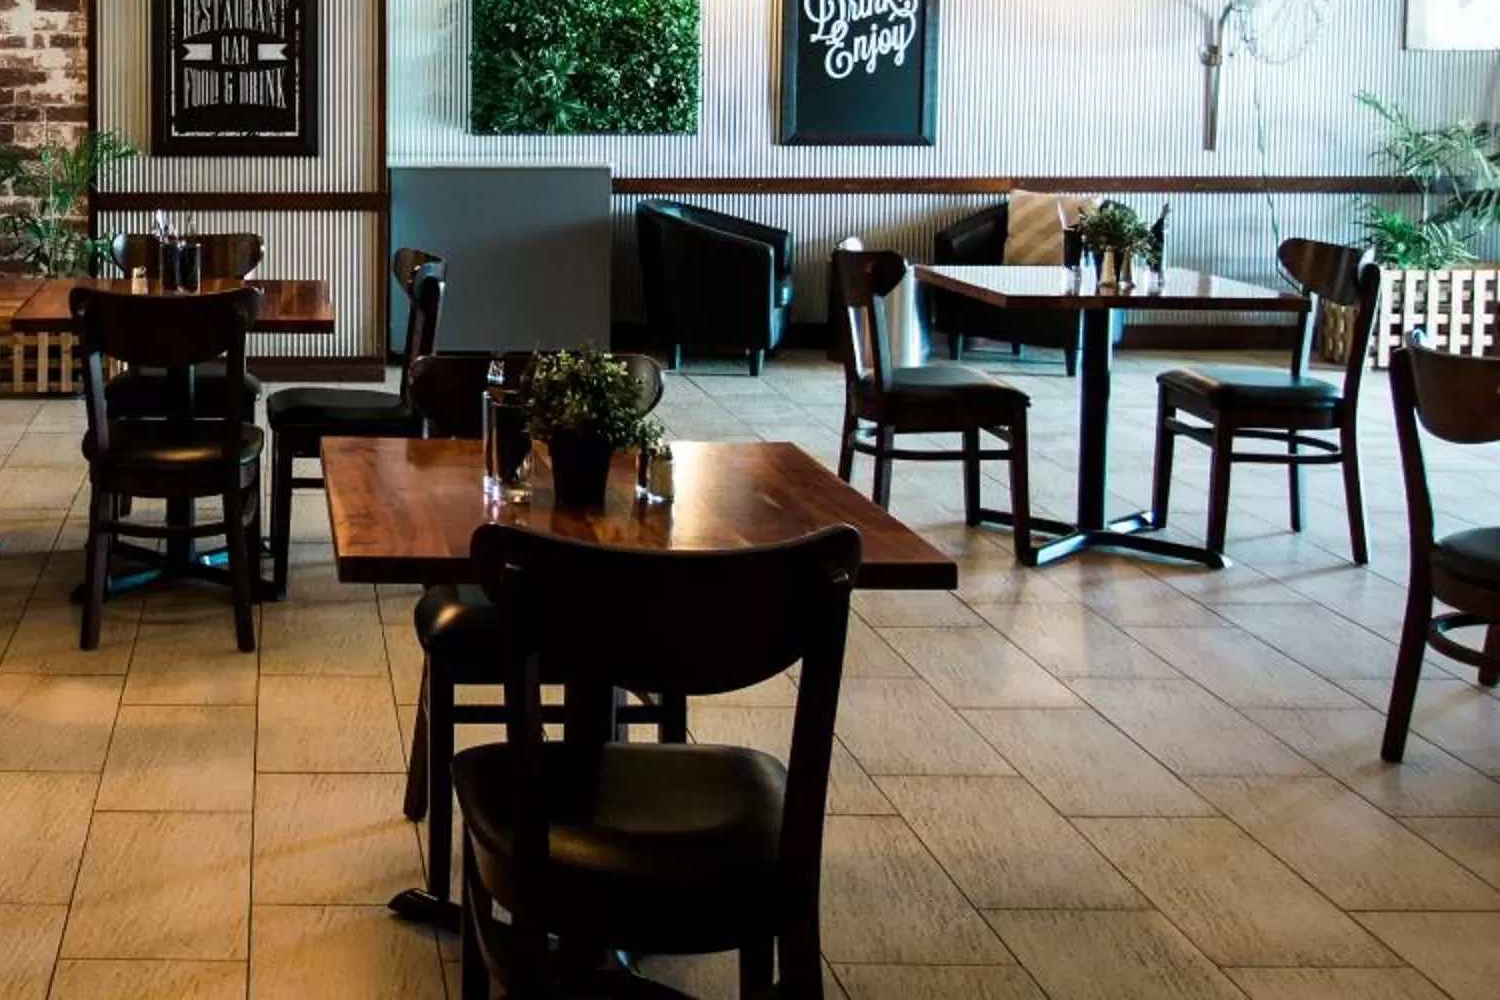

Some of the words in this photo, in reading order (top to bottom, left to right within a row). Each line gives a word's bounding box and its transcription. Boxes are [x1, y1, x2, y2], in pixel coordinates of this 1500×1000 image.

[221, 35, 249, 64] BAR
[825, 14, 916, 79] Enjoy
[183, 67, 219, 109] FOOD
[224, 71, 233, 104] &
[239, 67, 287, 109] DRINK
